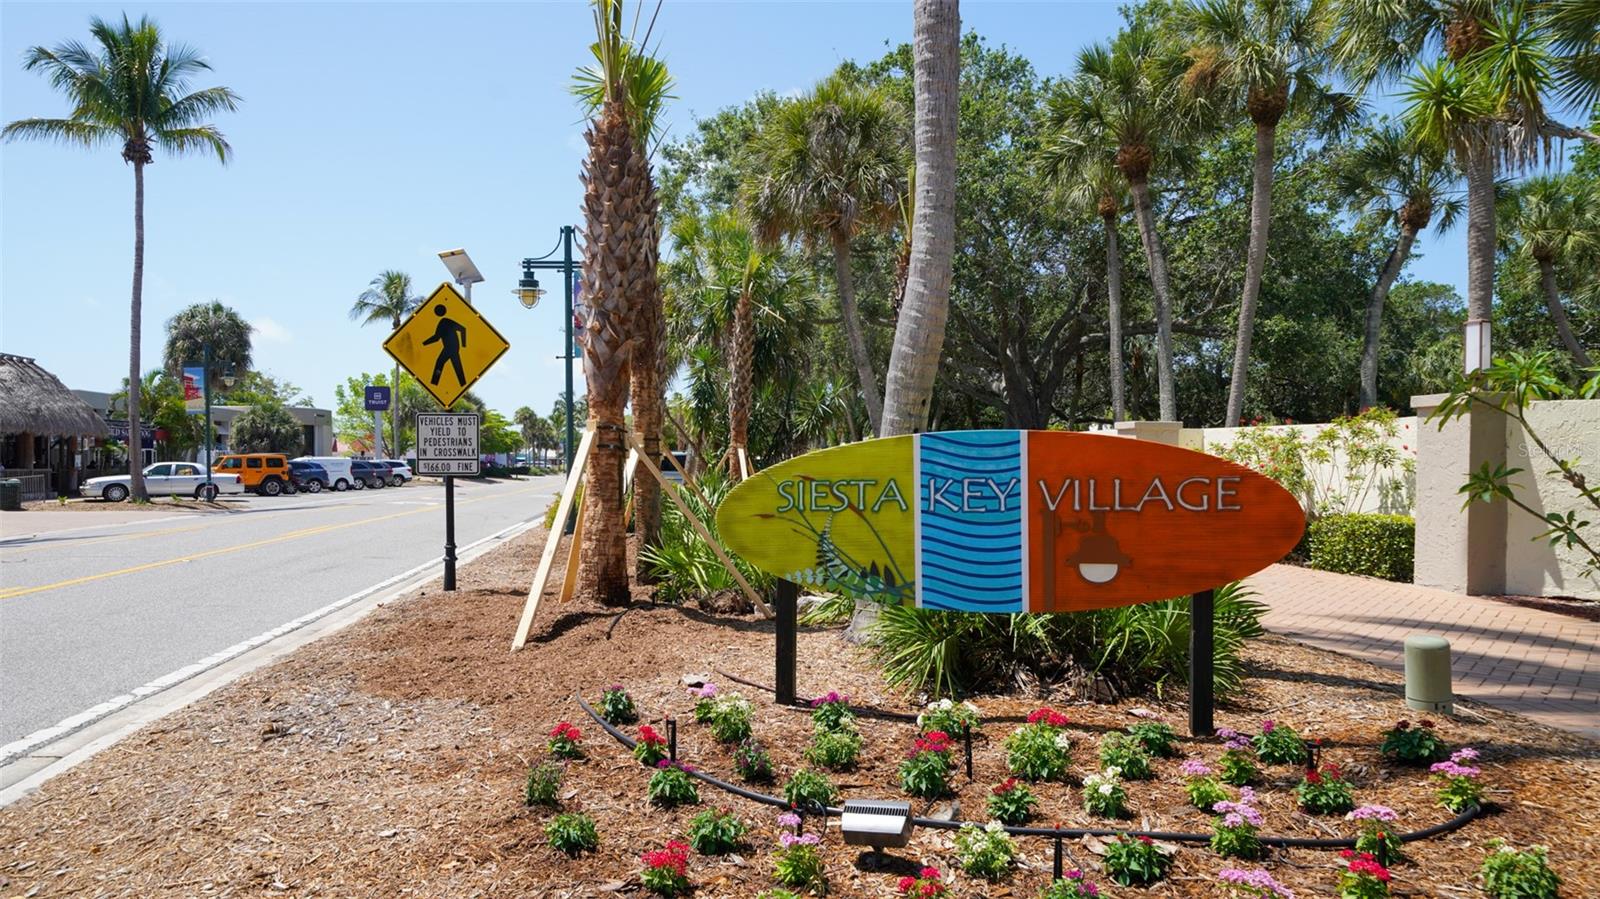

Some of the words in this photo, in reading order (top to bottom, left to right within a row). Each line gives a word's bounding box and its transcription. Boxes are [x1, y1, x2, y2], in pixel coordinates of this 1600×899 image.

[420, 416, 454, 426] VEHICLES
[457, 416, 476, 426] MUST
[430, 427, 451, 436] YIELD
[457, 427, 467, 436] TO
[423, 437, 473, 447] PEDESTRIANS
[420, 447, 427, 457] IN
[433, 447, 477, 457] CROSSWALK
[423, 462, 451, 472] $166.00
[457, 462, 473, 472] FINE
[776, 478, 909, 513] SIESTA
[927, 476, 1020, 514] KEY
[1038, 476, 1242, 513] VILLAGE
